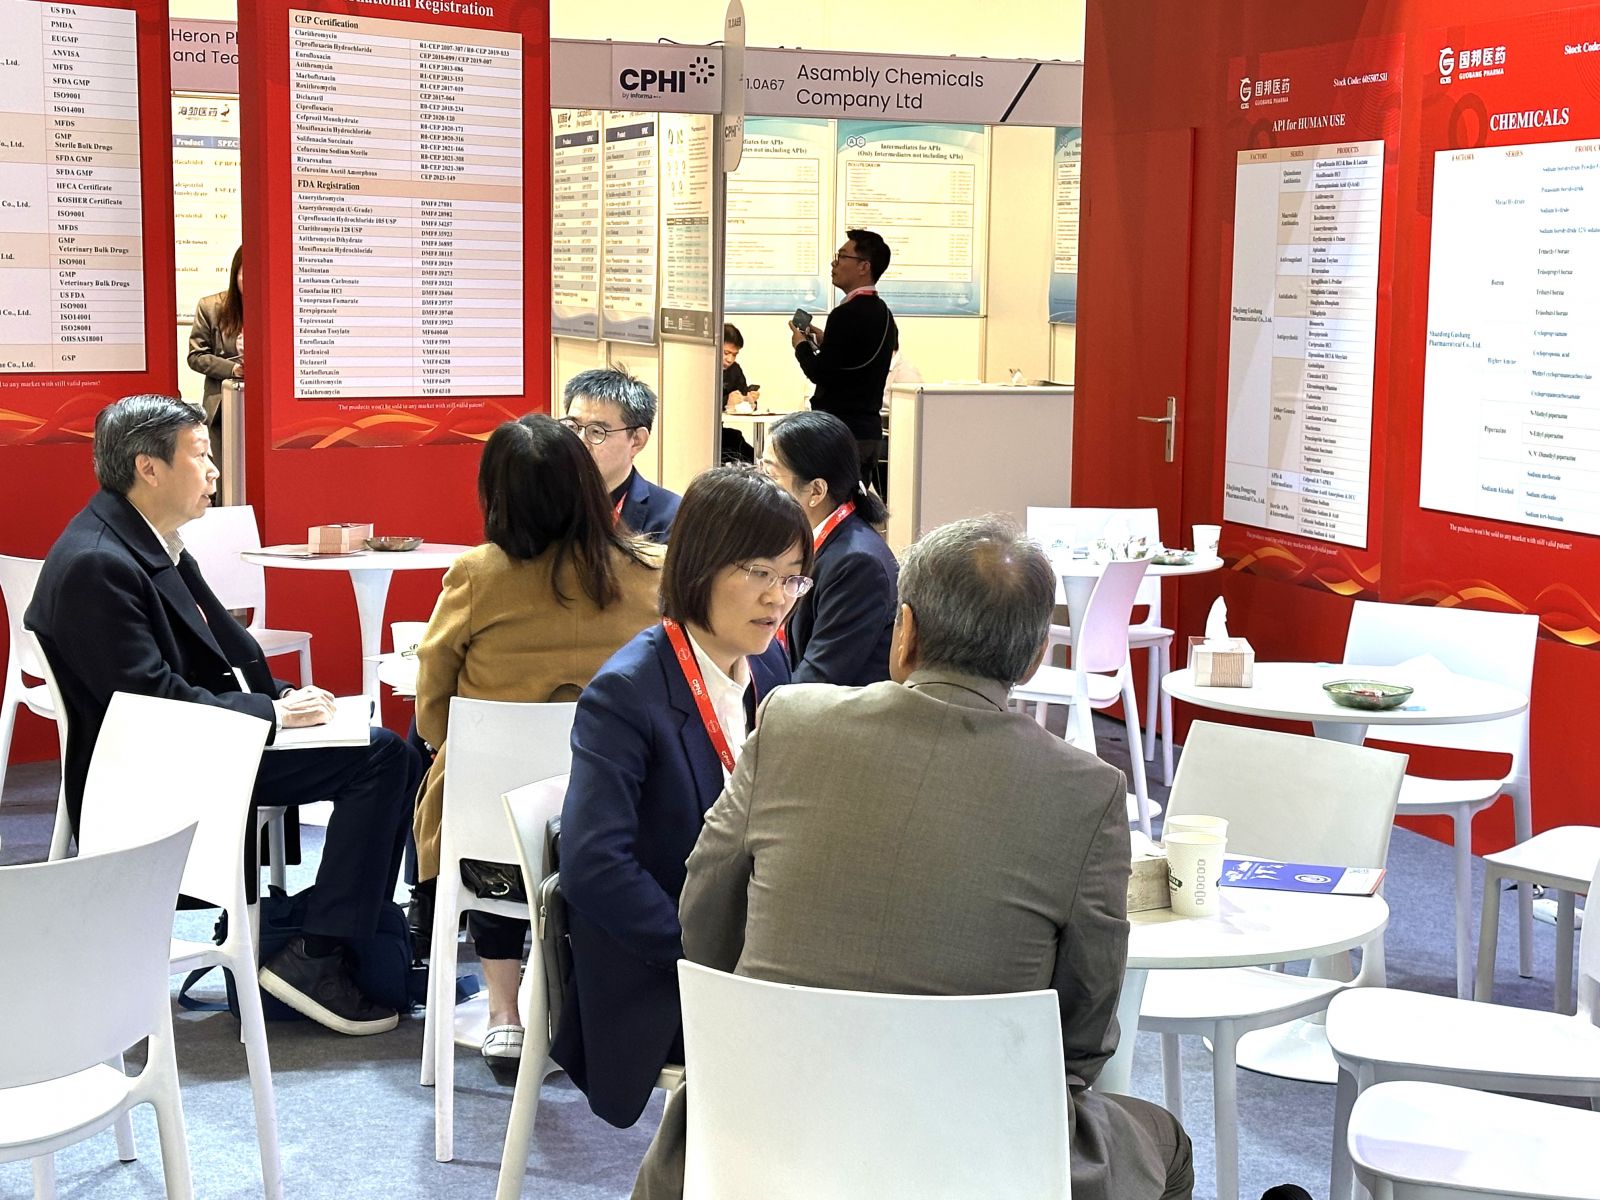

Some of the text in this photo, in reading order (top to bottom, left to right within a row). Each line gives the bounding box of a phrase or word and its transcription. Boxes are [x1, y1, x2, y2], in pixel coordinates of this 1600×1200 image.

[415, 0, 494, 17] Registration
[51, 21, 73, 29] PMDA
[295, 14, 358, 29] CEP Certification
[52, 35, 78, 44] EUGMP
[172, 28, 220, 44] Heron
[52, 49, 80, 58] ANVISA
[1564, 44, 1582, 55] Stock
[173, 49, 206, 63] and
[1459, 46, 1506, 69] 国邦医药
[797, 64, 984, 88] Asambly Chemicals
[1459, 68, 1504, 80] GUOBANG PHARMA
[53, 77, 71, 85] SFDA
[620, 68, 686, 93] CPHI
[746, 78, 784, 91] 1.0A67
[1333, 78, 1346, 87] Stock
[1255, 77, 1290, 97] 国邦医药
[54, 91, 80, 100] ISO9001
[796, 89, 922, 112] Company Ltd
[54, 106, 85, 114] ISO14001
[1272, 113, 1346, 132] API for HUMAN USE
[1490, 107, 1570, 132] CHEMICALS
[55, 141, 112, 151] Sterile Bulk Drugs
[176, 138, 204, 146] Product
[1337, 146, 1359, 154] PRODUCTS
[76, 155, 92, 163] GMP
[56, 168, 74, 176] SFDA
[298, 179, 360, 191] FDA Registration
[58, 196, 122, 206] KOSHER Certificate
[58, 210, 84, 218] ISO9001
[59, 245, 92, 253] Veterinary
[59, 258, 86, 266] ISO9001
[60, 279, 93, 287] Veterinary
[111, 280, 129, 288] Drugs
[692, 678, 702, 696] CPHI
